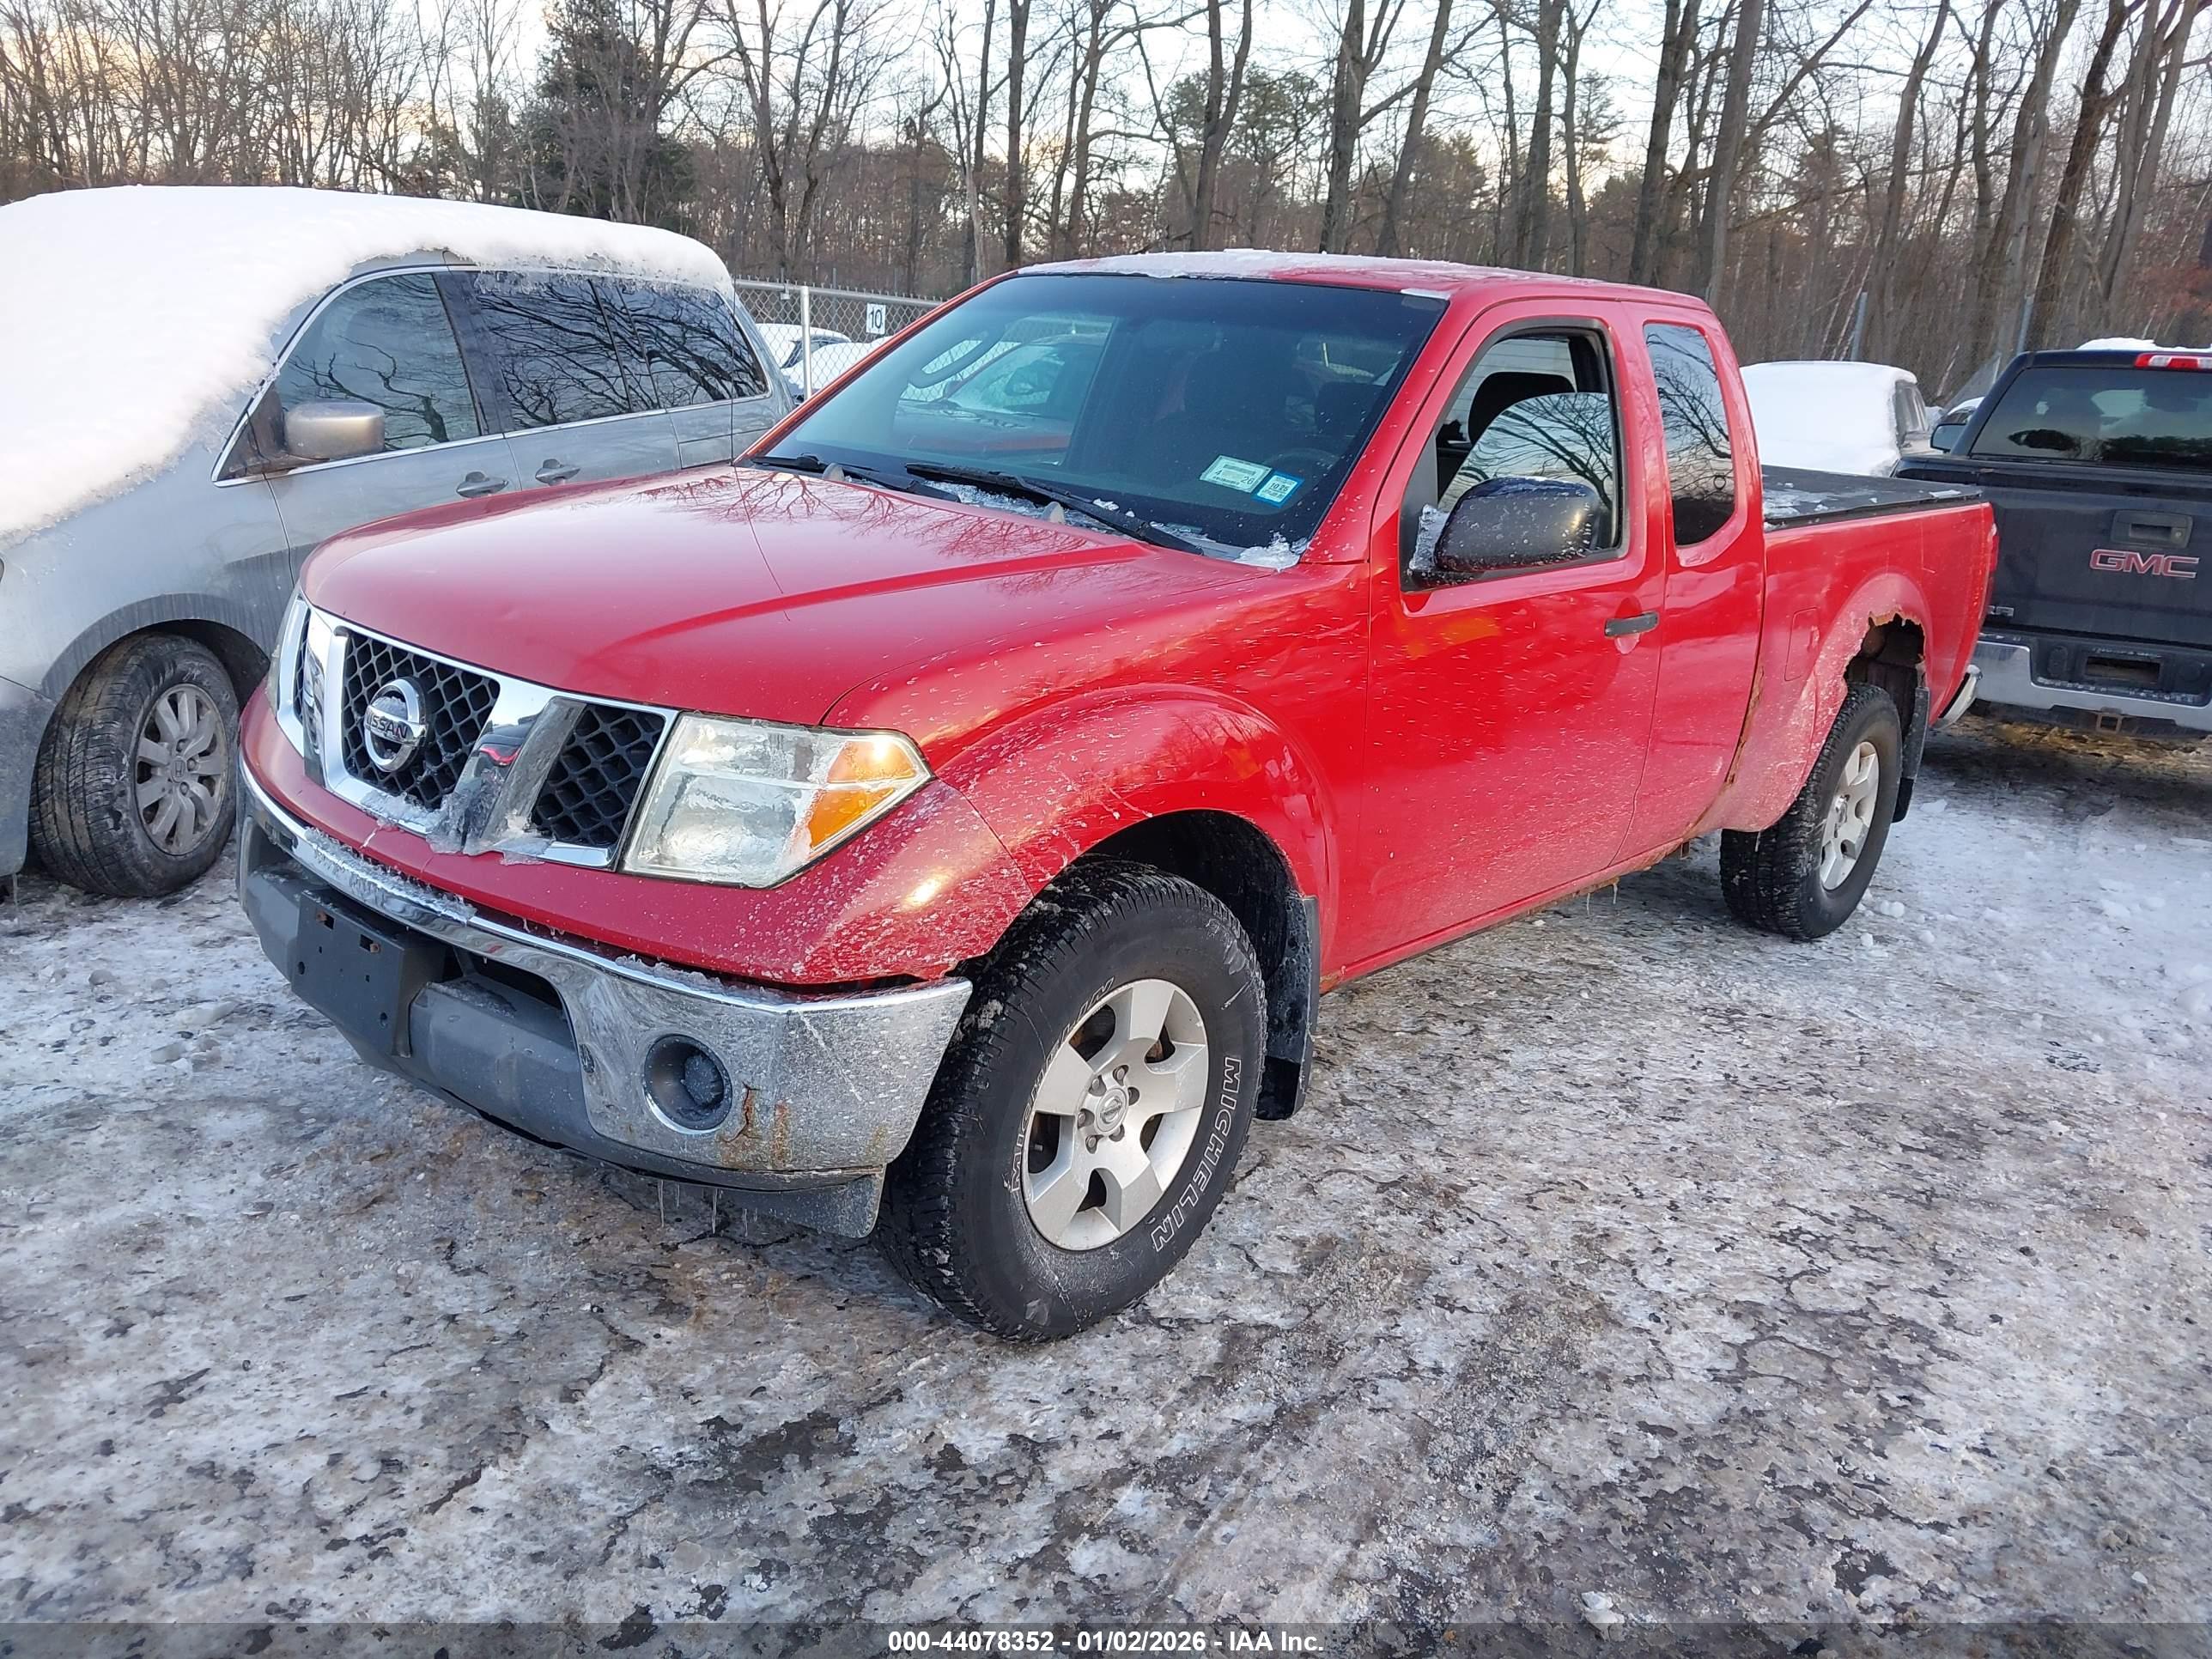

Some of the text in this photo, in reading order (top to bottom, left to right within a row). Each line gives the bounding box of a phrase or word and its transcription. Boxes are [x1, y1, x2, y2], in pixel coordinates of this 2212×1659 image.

[870, 308, 883, 329] 10
[2089, 549, 2200, 579] GMC
[366, 712, 409, 739] NISSAN
[1151, 1057, 1243, 1253] MICHELIN
